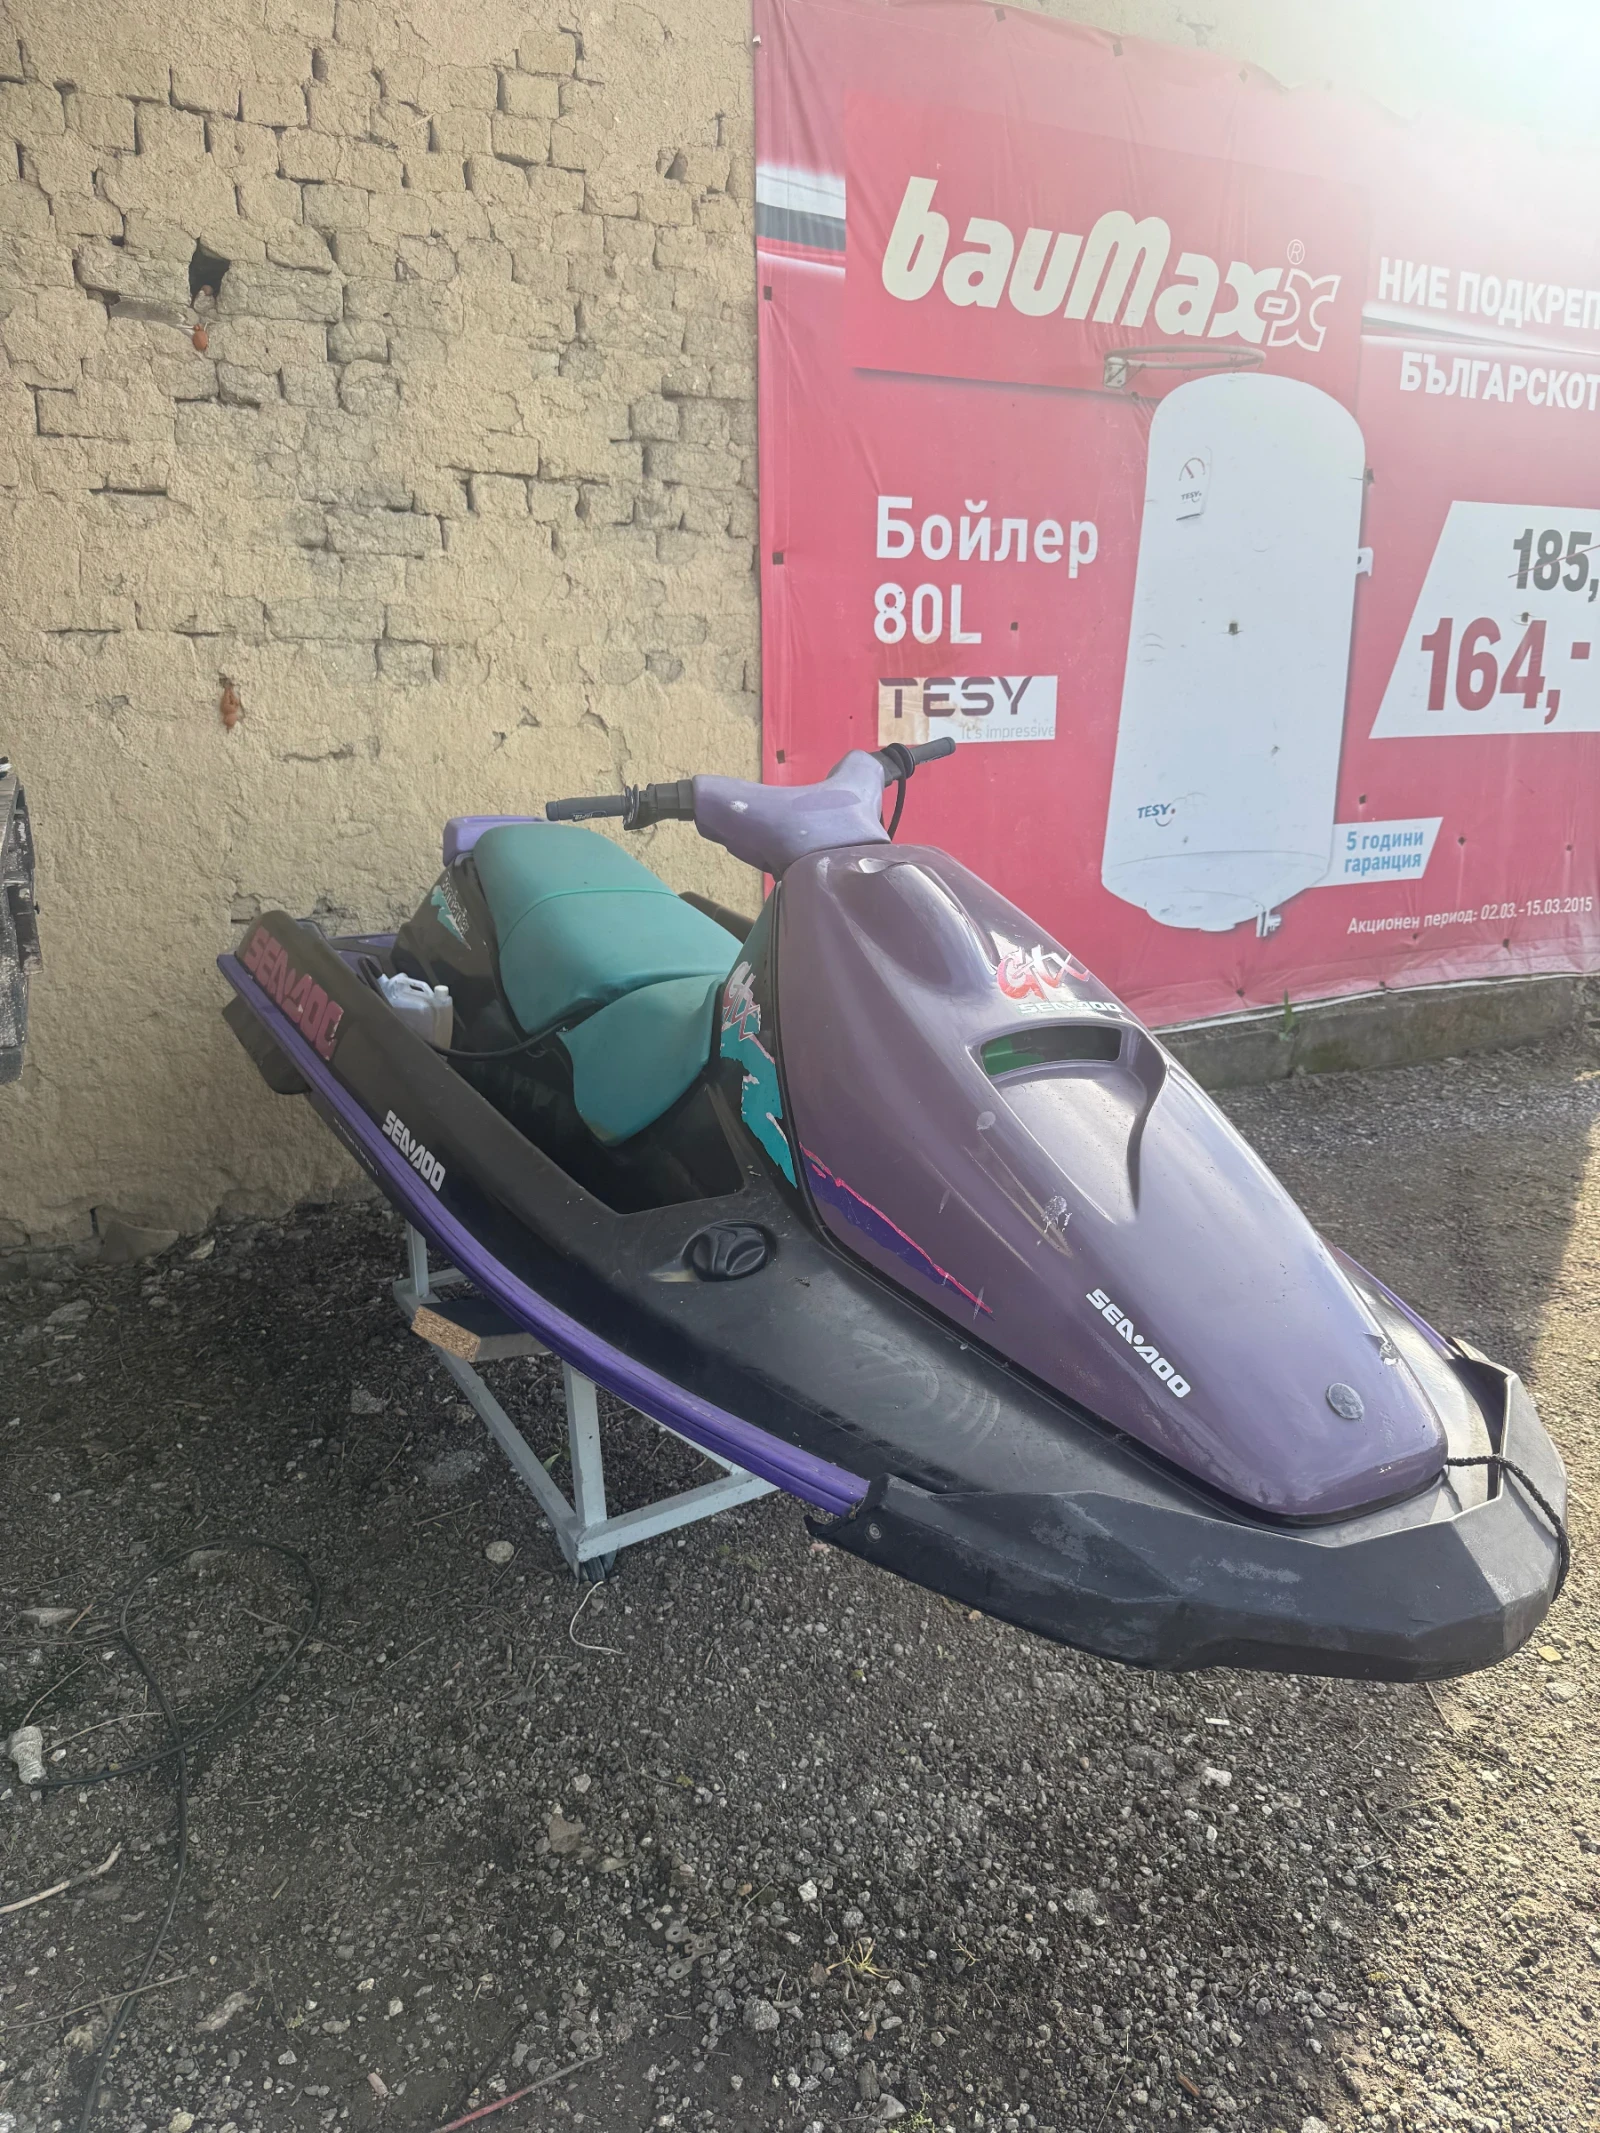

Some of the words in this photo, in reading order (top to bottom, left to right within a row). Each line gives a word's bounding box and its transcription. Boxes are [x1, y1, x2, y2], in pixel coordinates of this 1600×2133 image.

[1378, 256, 1450, 309] НИЕ
[876, 495, 1098, 579] Бойлер
[874, 582, 982, 644] 80L
[879, 676, 1032, 719] TESY
[986, 722, 1055, 743] impressive
[1346, 831, 1357, 851] 5
[1362, 831, 1424, 852] години
[1344, 853, 1422, 876] гаранция
[1347, 916, 1420, 935] Акционен
[1424, 909, 1478, 928] период:
